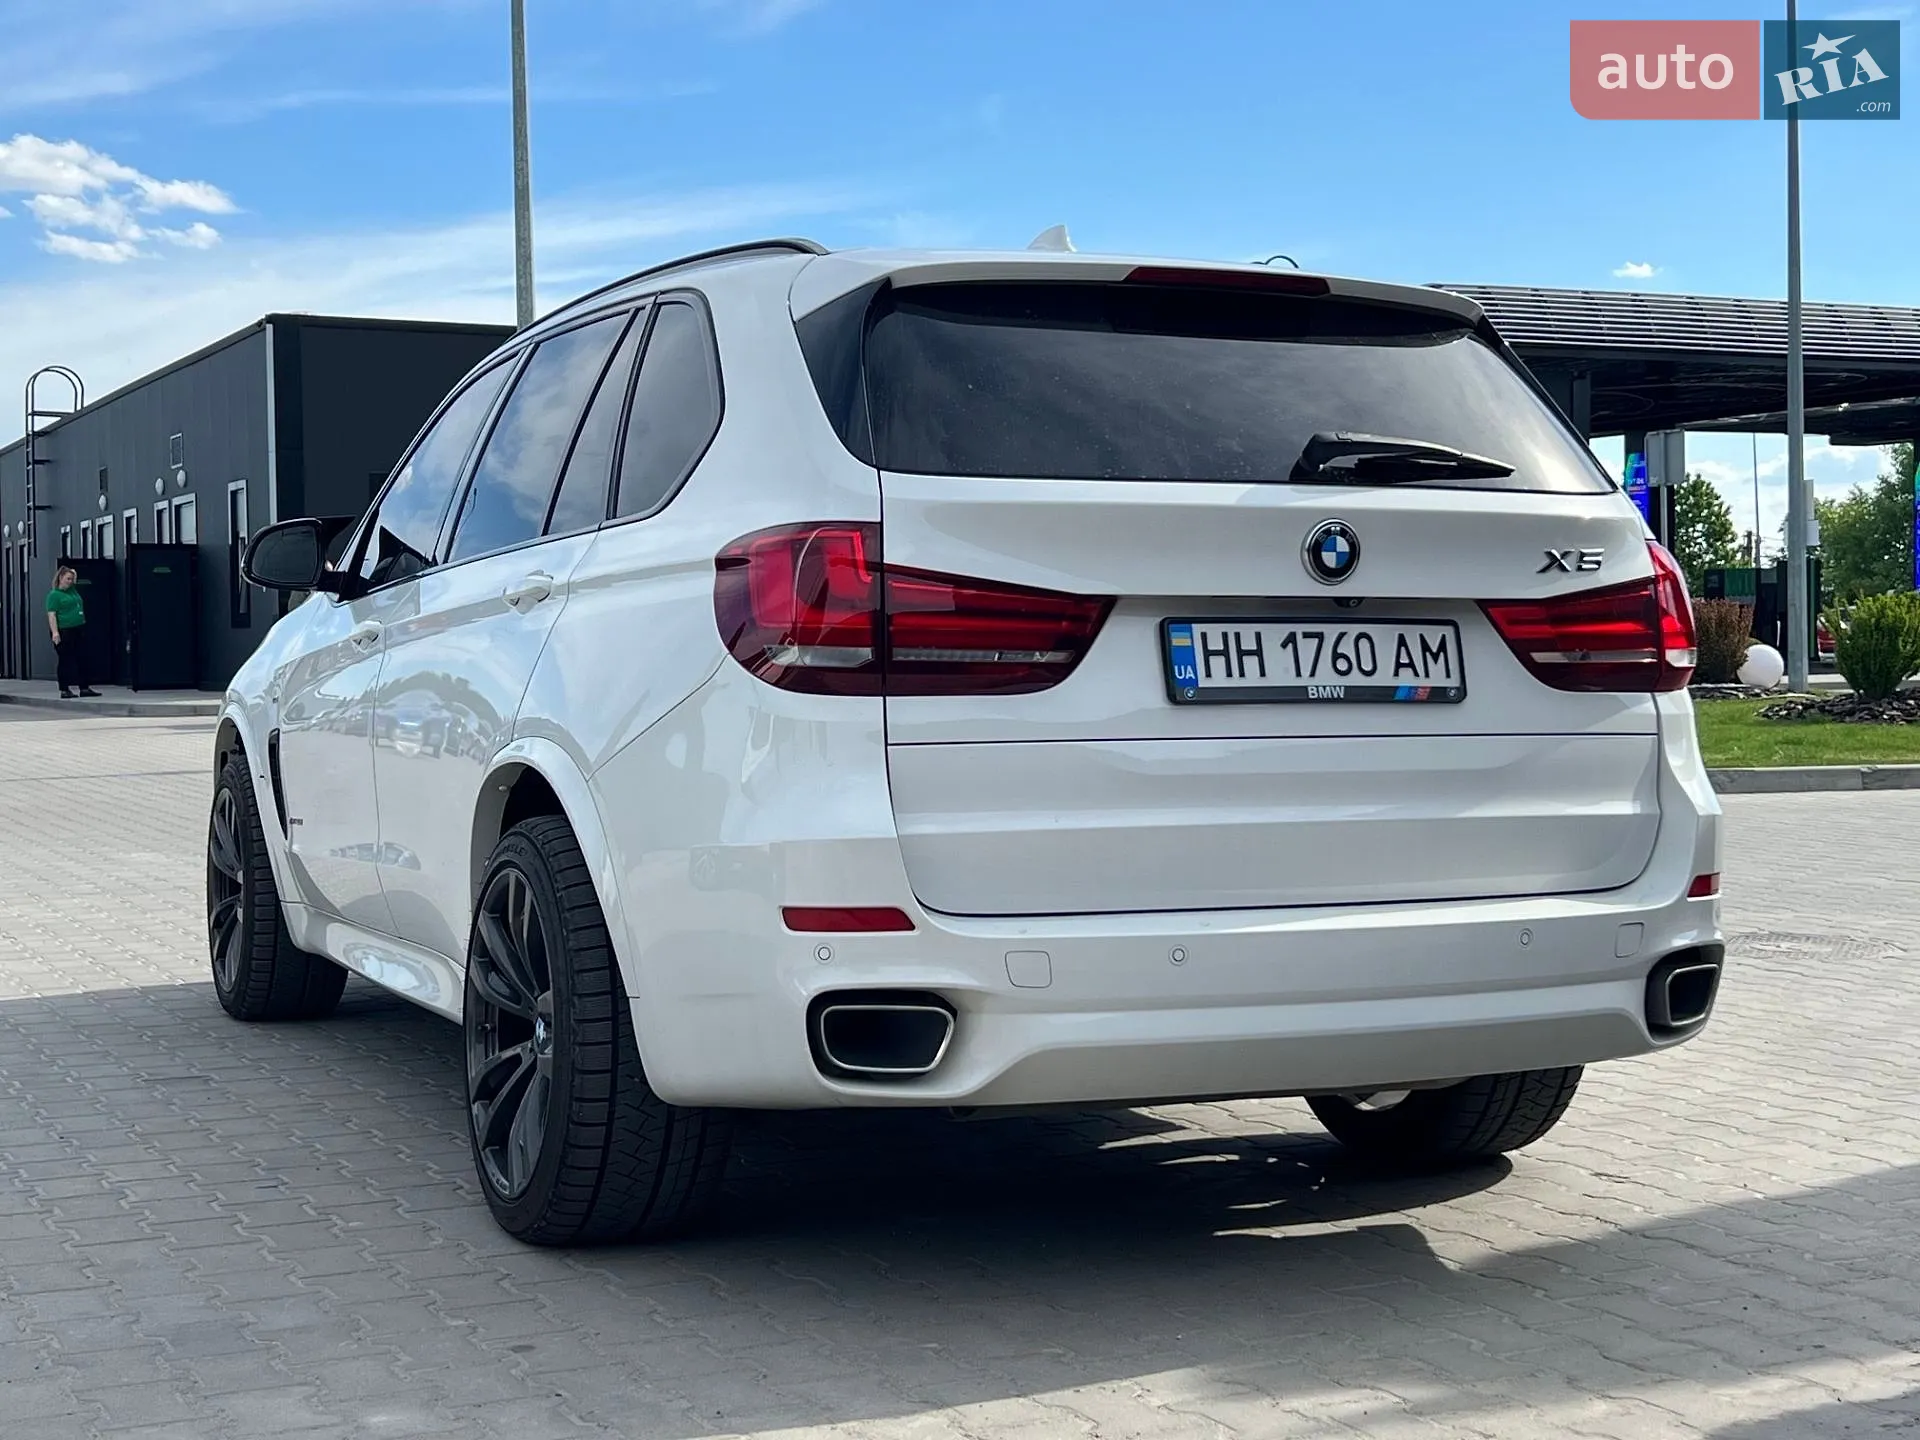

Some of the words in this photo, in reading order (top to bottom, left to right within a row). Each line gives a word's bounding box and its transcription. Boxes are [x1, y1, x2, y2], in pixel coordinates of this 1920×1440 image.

[1536, 548, 1604, 573] X5
[1200, 631, 1266, 678] HH
[1280, 631, 1378, 677] 1760
[1393, 632, 1451, 679] AM
[1174, 664, 1195, 679] UA
[1308, 686, 1345, 699] BMW
